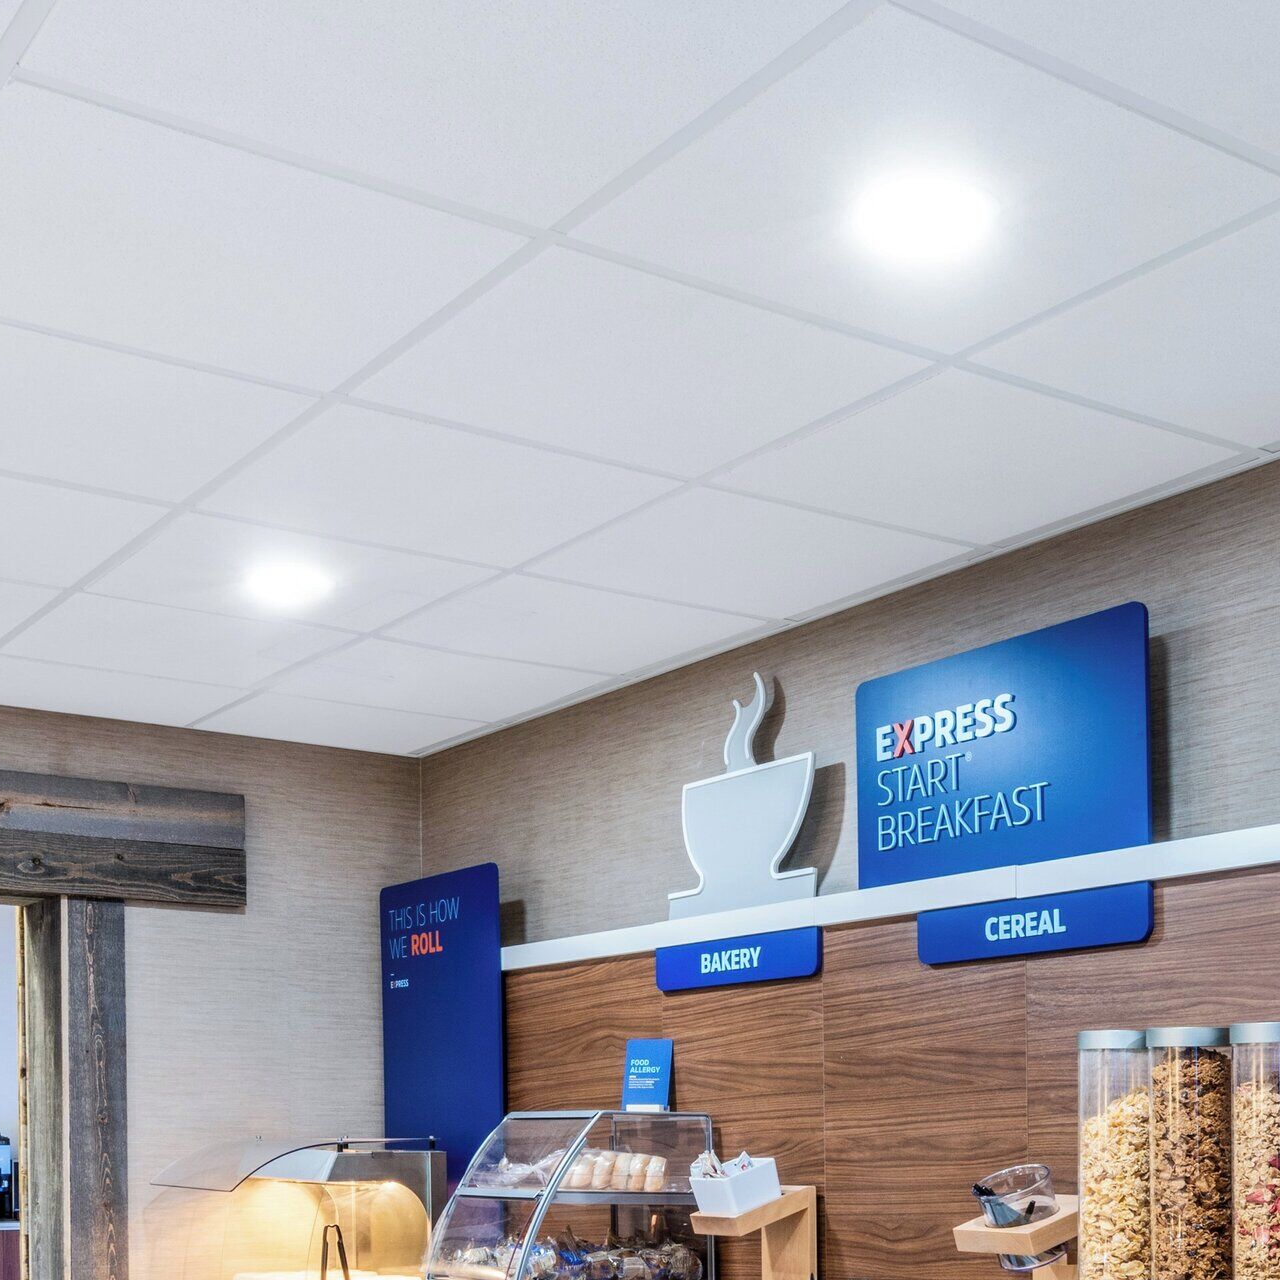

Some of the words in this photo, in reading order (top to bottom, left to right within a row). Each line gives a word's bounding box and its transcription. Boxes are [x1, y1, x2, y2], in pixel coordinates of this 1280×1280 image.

[876, 693, 1016, 762] EXPRESS
[877, 781, 1051, 852] BREAKFAST
[388, 906, 413, 932] THIS
[416, 903, 426, 927] IS
[429, 897, 460, 924] HOW
[984, 907, 1067, 942] CEREAL
[389, 936, 408, 960] WE
[411, 930, 443, 956] ROLL
[700, 945, 762, 974] BAKERY
[630, 1058, 650, 1067] FOOD
[630, 1066, 661, 1074] ALLERGY
